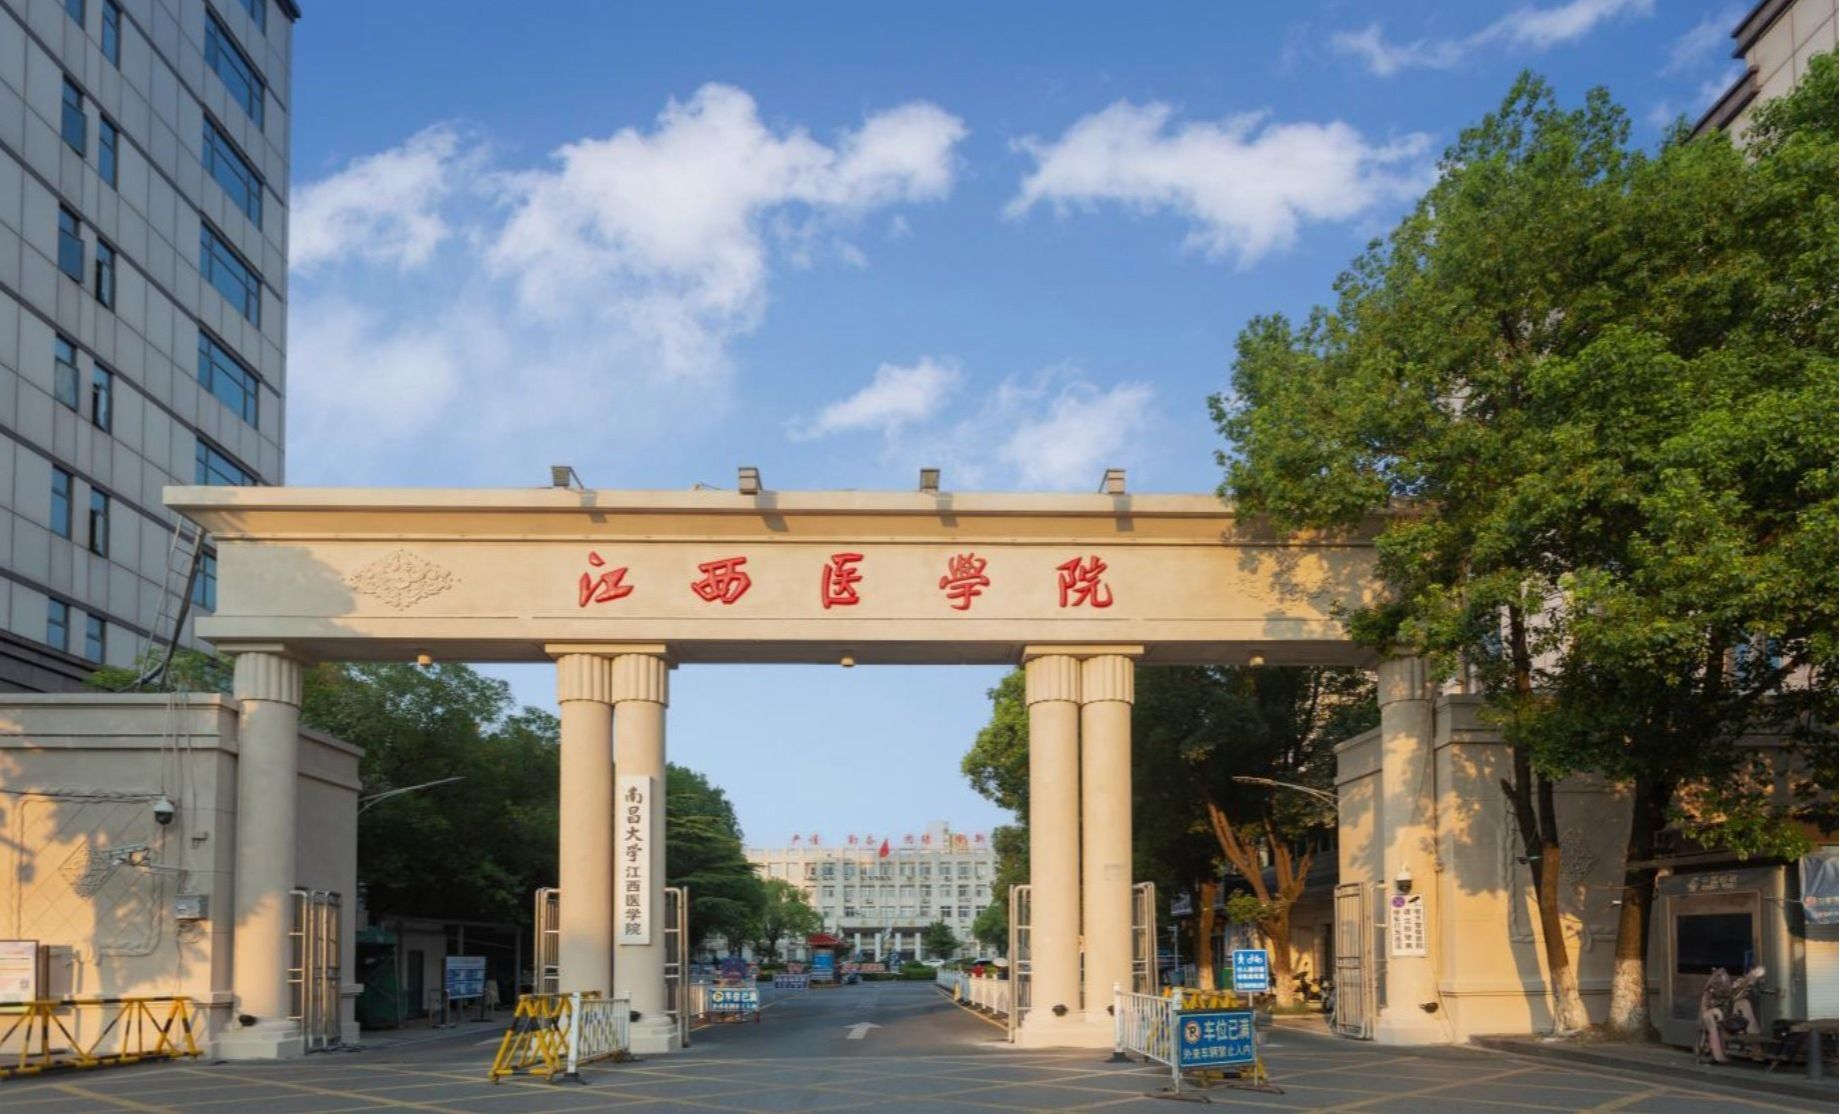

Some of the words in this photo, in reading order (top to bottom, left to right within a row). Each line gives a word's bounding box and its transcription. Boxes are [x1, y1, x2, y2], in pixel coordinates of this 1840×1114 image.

[625, 786, 643, 936] 南昌大学江西医学院
[1203, 1019, 1250, 1041] 车位已满
[1183, 1045, 1251, 1059] 外来车辆禁止入内
